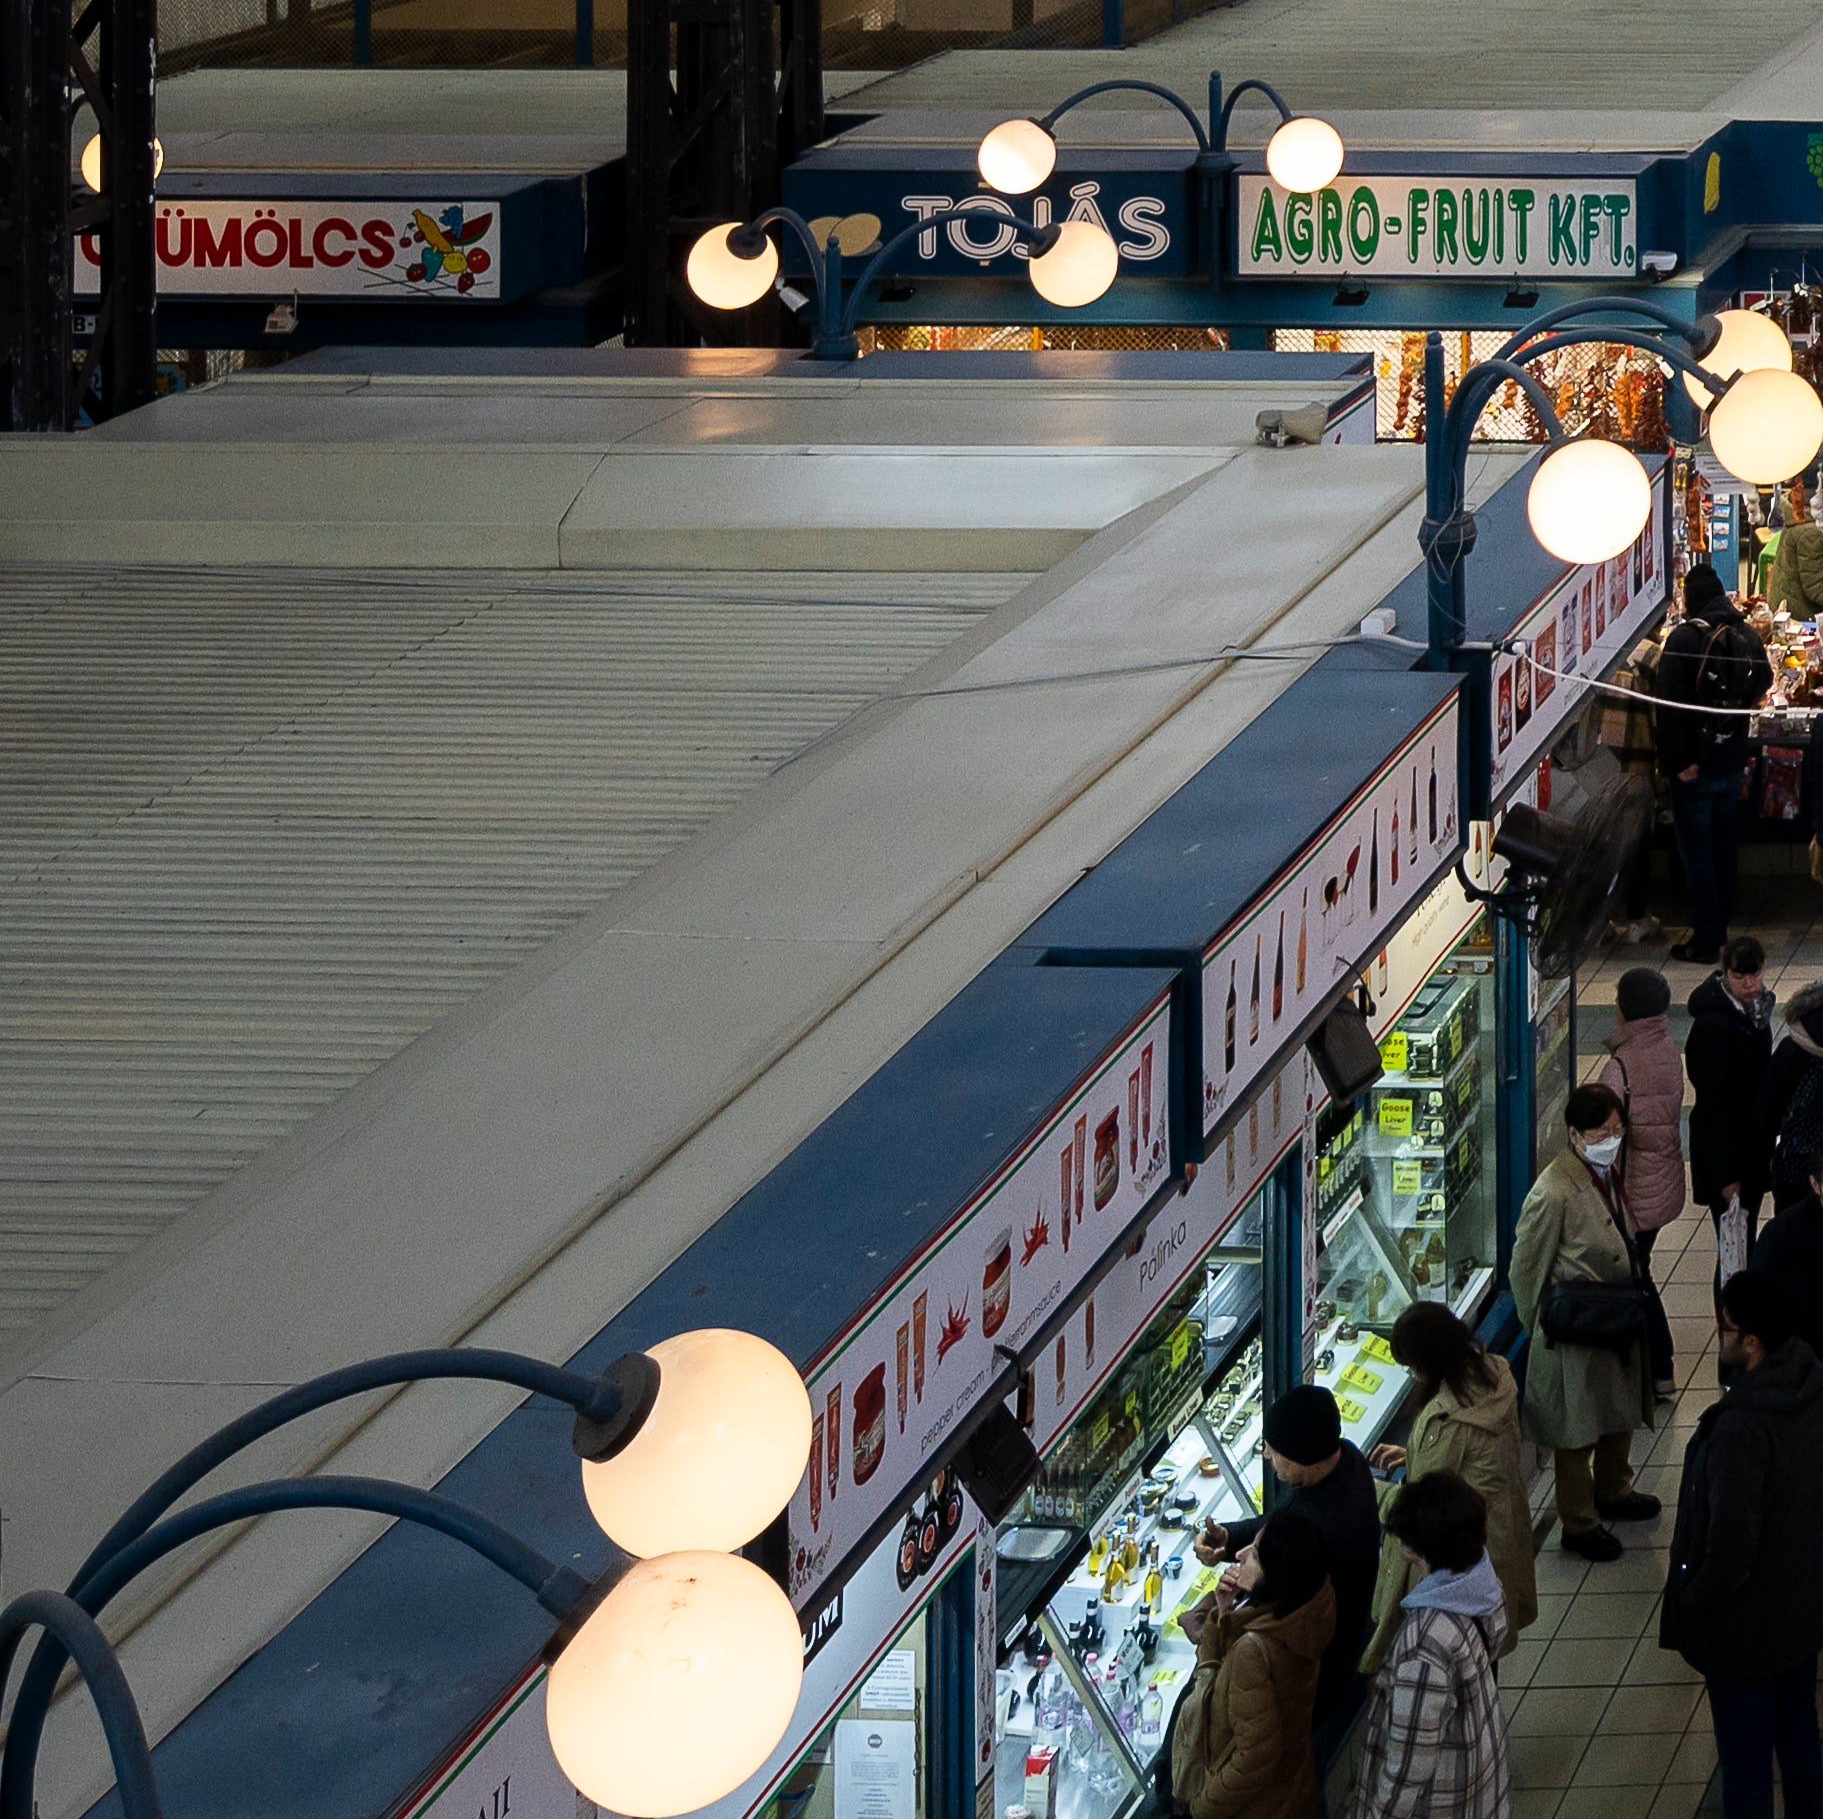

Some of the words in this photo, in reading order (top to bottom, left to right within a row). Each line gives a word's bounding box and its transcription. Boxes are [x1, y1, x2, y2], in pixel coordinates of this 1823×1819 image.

[1251, 185, 1535, 266] AGRO-FRUIT
[1548, 193, 1635, 268] KFT.
[1381, 1102, 1411, 1113] Goose
[1384, 1115, 1407, 1124] Liver
[1139, 1219, 1187, 1293] Pálinka
